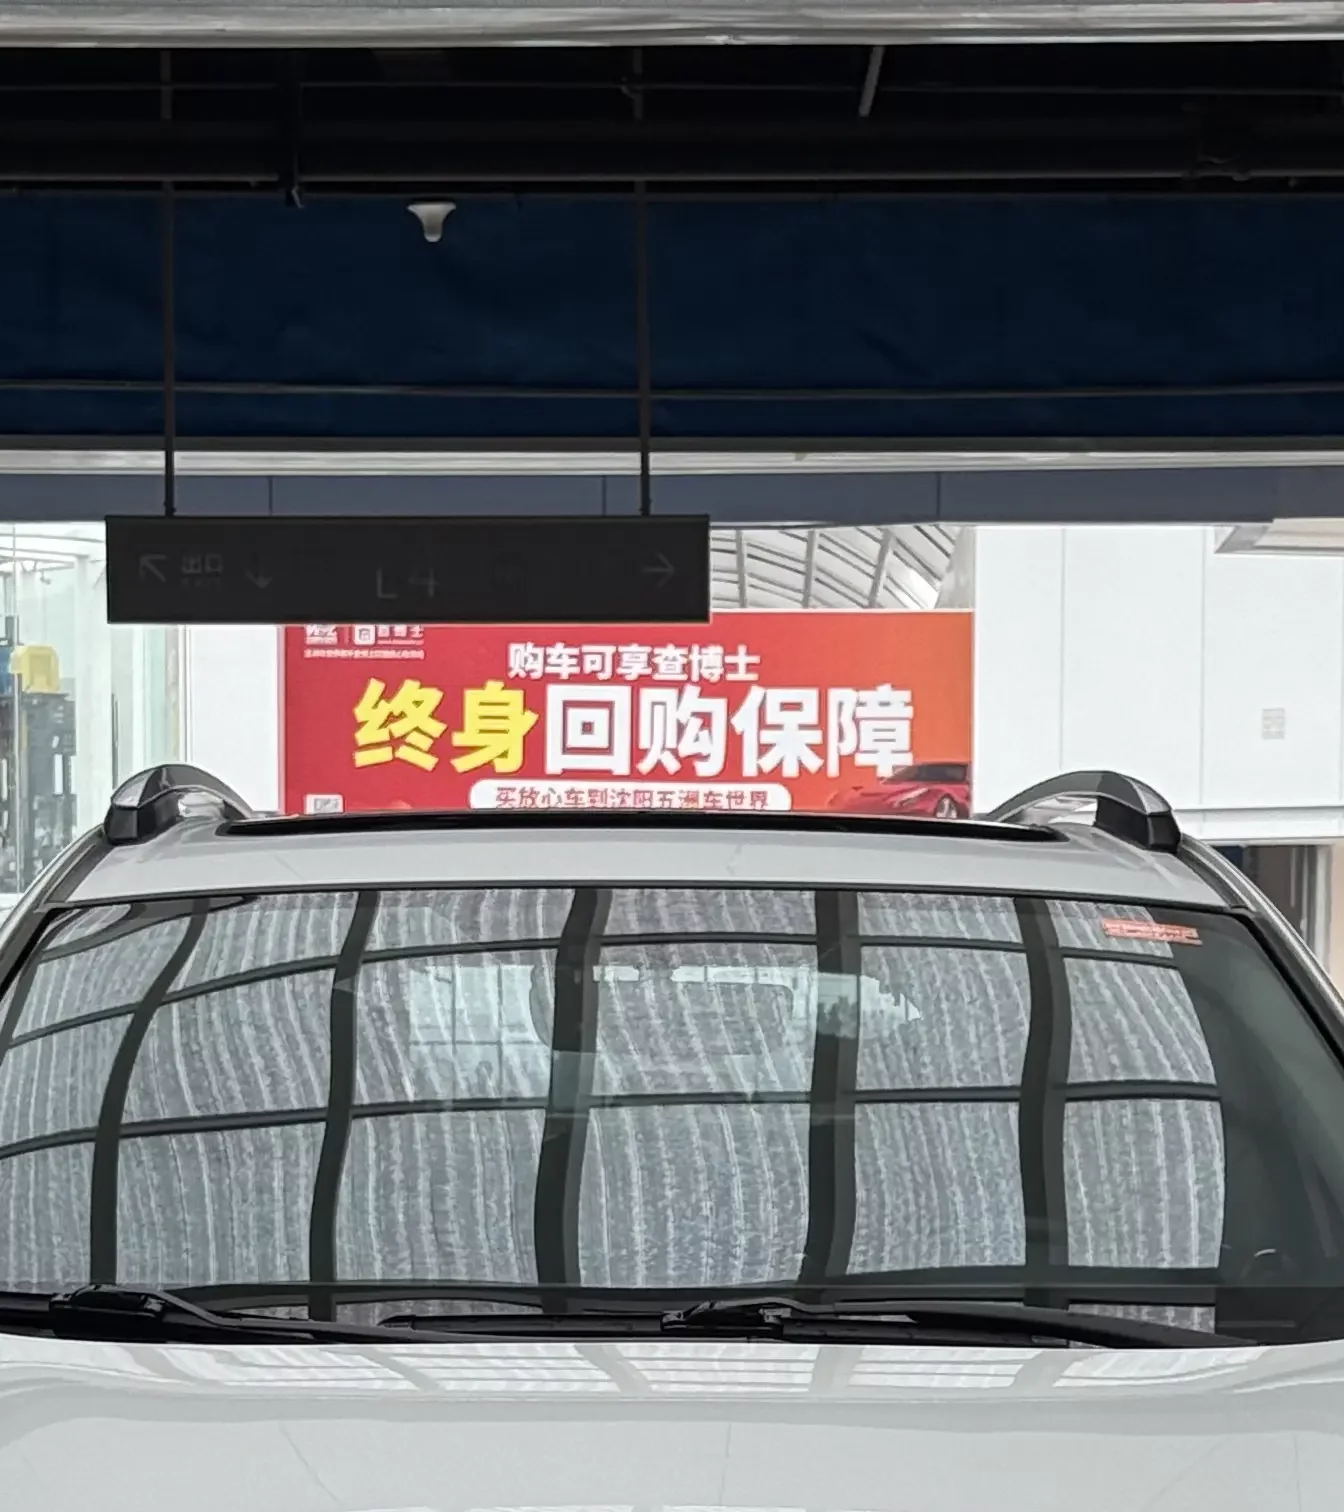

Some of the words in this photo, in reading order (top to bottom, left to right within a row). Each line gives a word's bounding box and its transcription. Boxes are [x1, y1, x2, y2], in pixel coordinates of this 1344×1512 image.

[507, 641, 761, 682] 购车可享查博士
[353, 677, 915, 778] 终身回购保障
